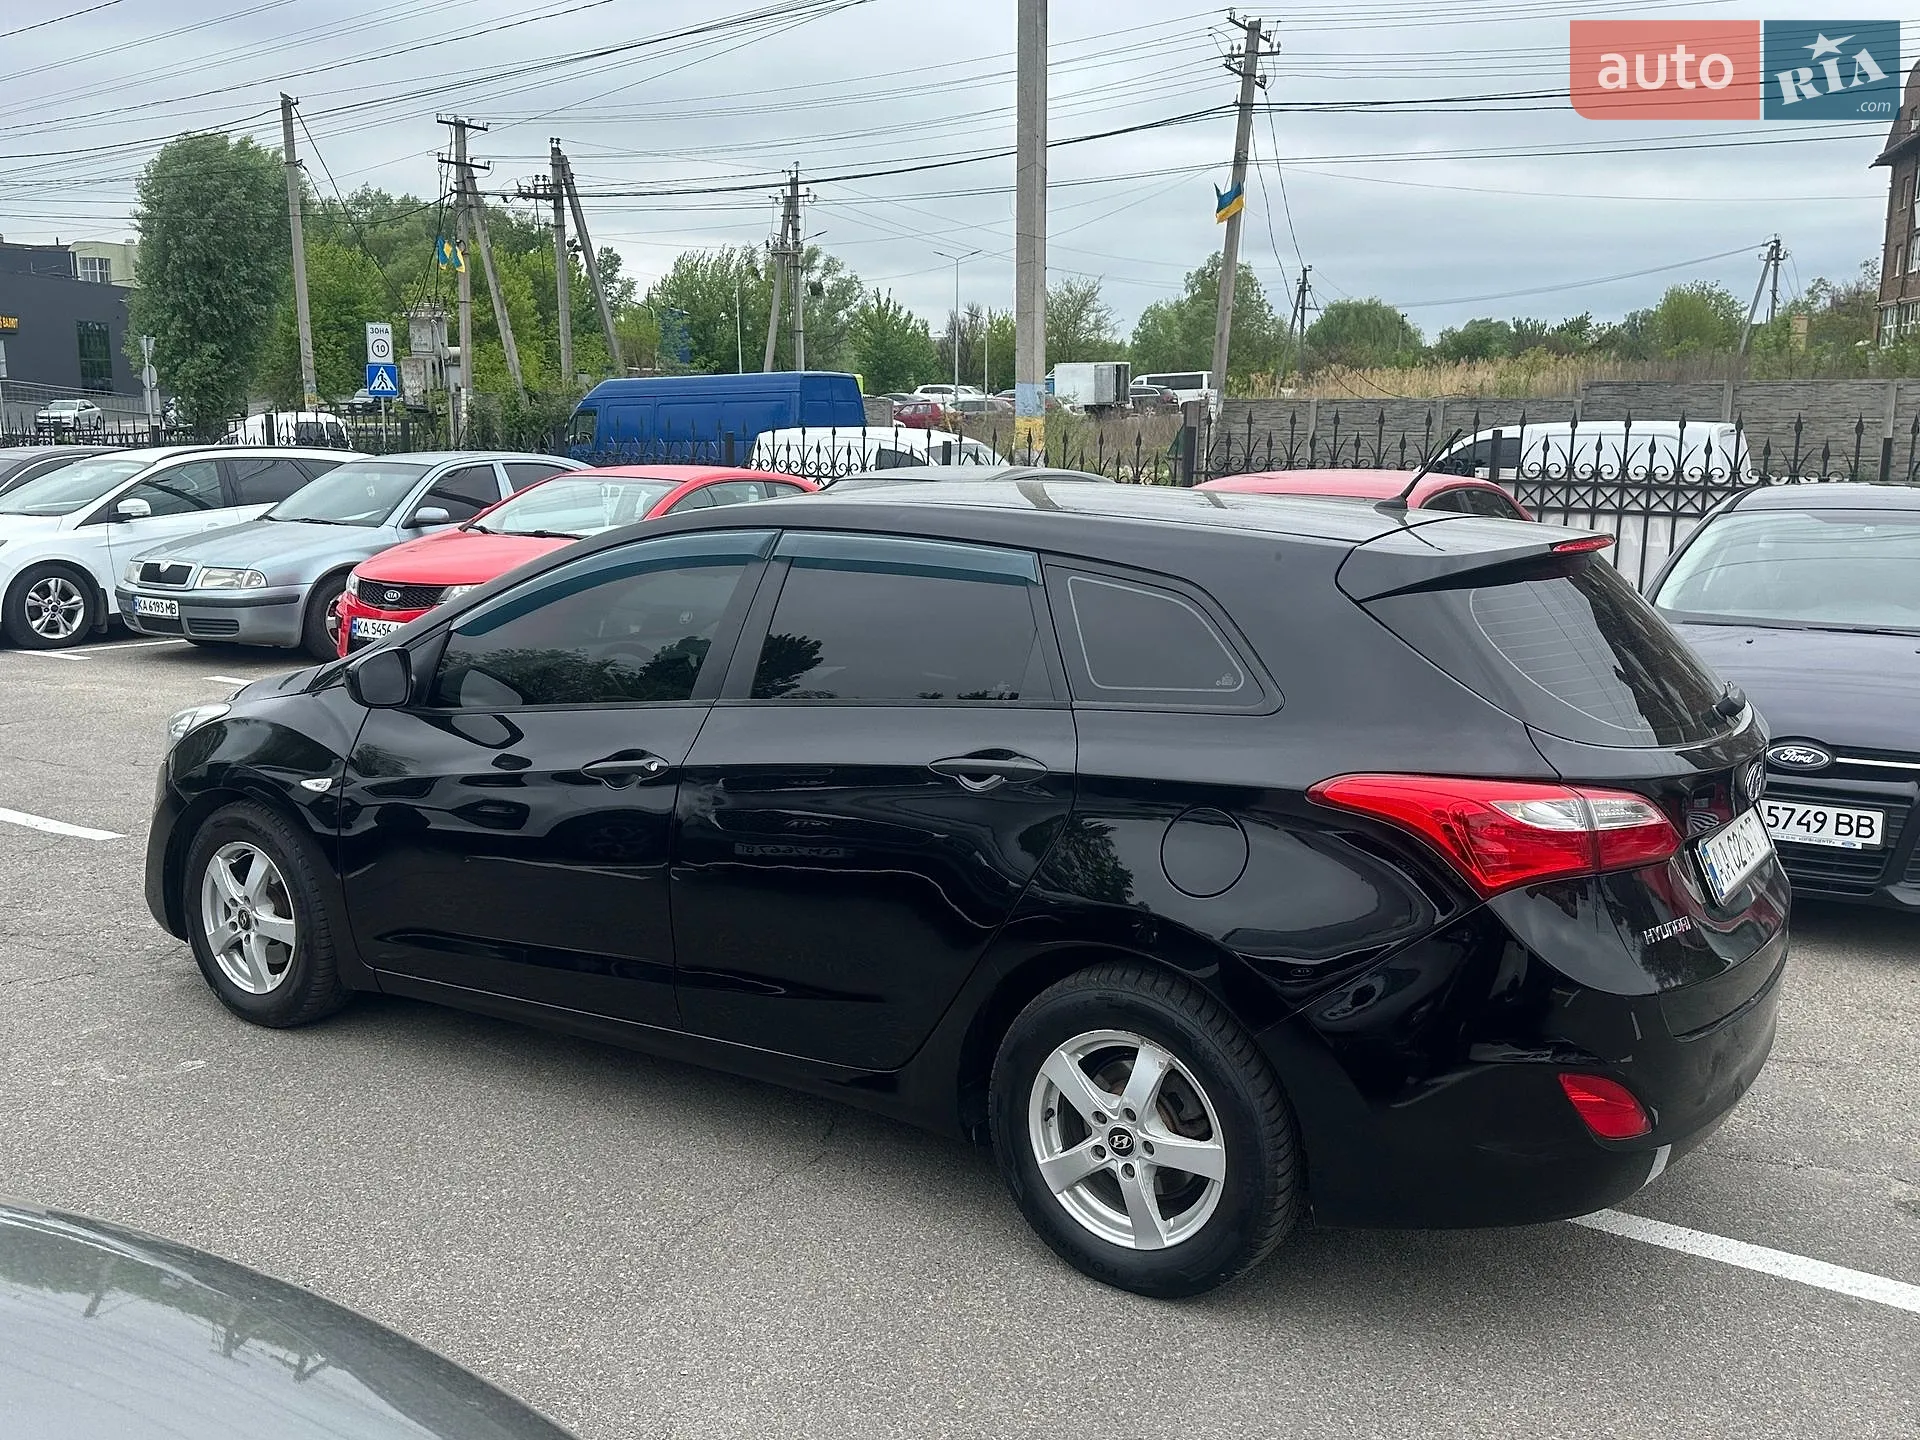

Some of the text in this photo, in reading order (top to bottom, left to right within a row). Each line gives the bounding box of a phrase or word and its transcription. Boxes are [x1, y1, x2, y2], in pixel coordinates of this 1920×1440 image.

[369, 327, 390, 335] ЗОНА
[138, 600, 177, 615] KA 6193 MB
[358, 621, 369, 634] KA
[1780, 748, 1815, 764] Ford
[1766, 805, 1875, 839] 5749 BB
[1643, 915, 1691, 945] HYUNDAI
